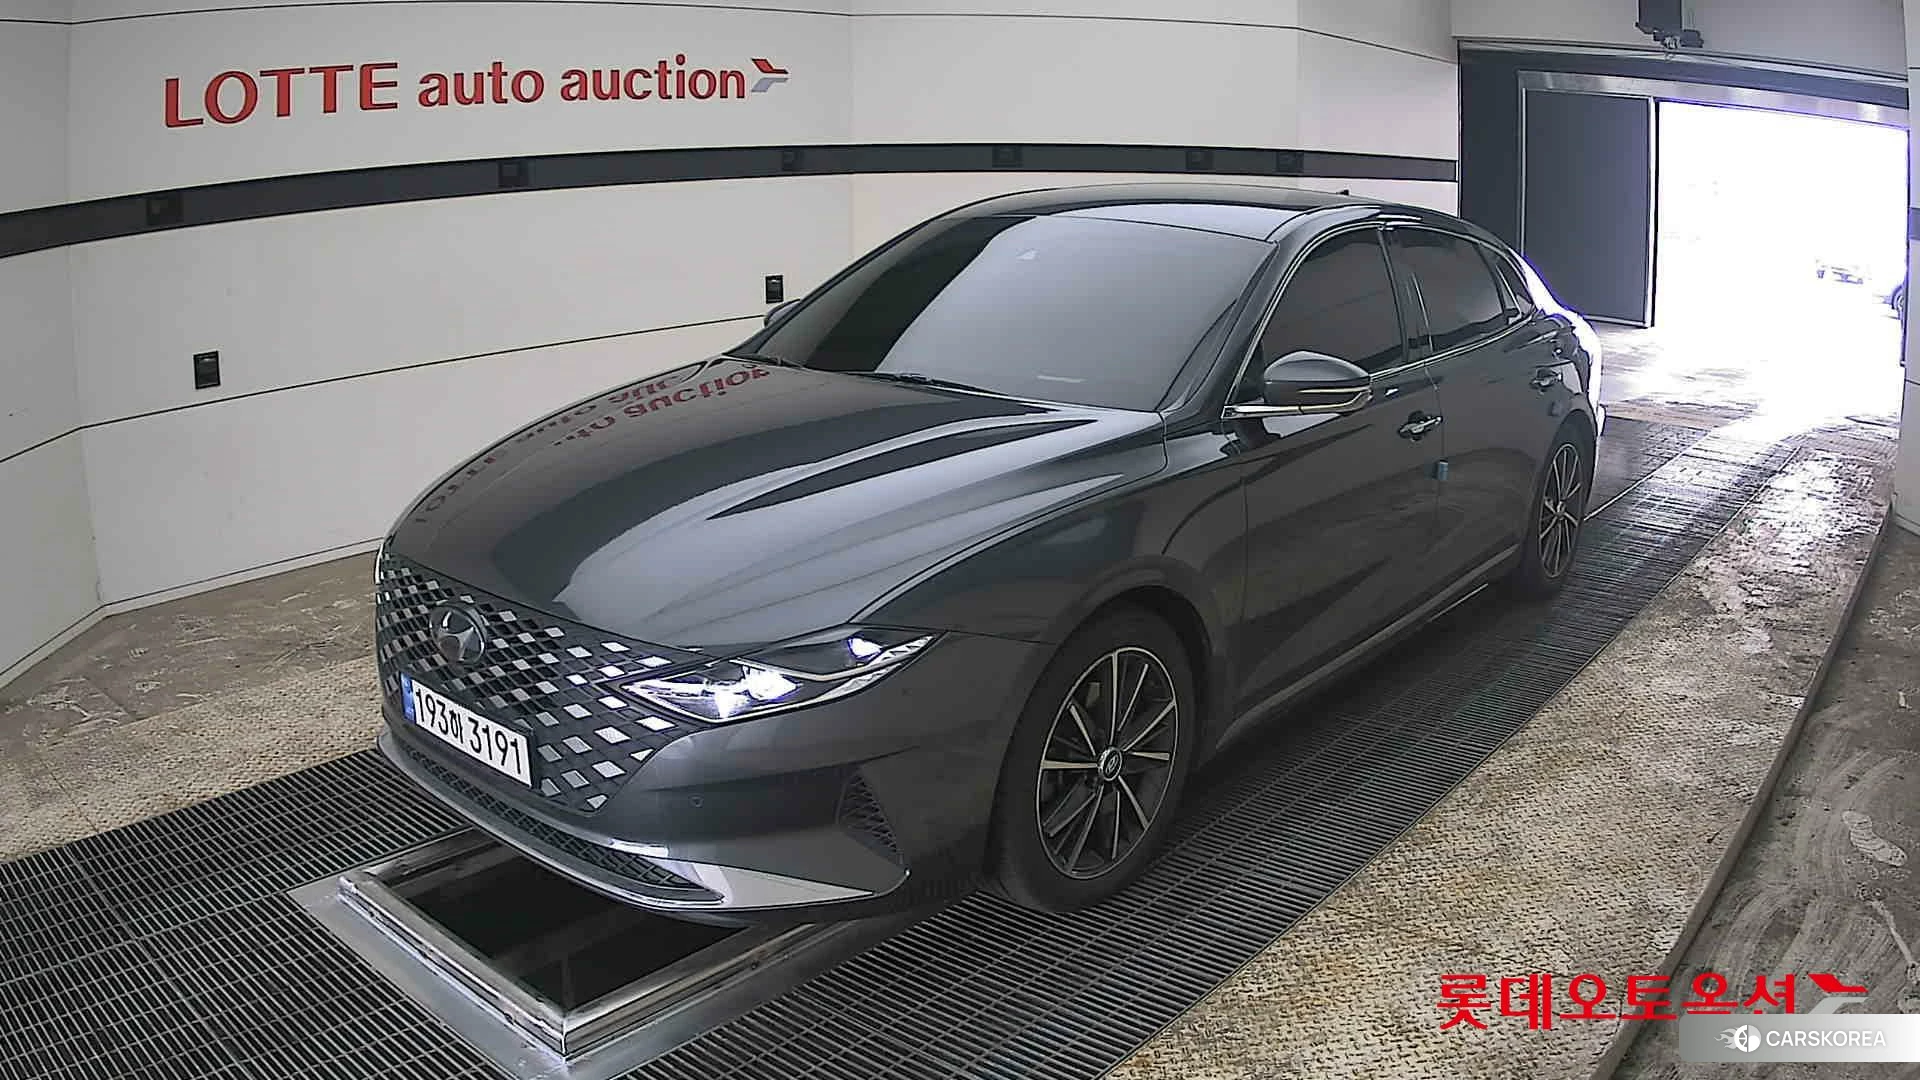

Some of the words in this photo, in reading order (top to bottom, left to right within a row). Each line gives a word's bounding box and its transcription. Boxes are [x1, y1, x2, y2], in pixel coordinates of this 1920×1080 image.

[164, 62, 399, 128] LOTTE
[417, 60, 545, 108] auto
[560, 53, 747, 102] auction
[467, 716, 522, 775] 3191
